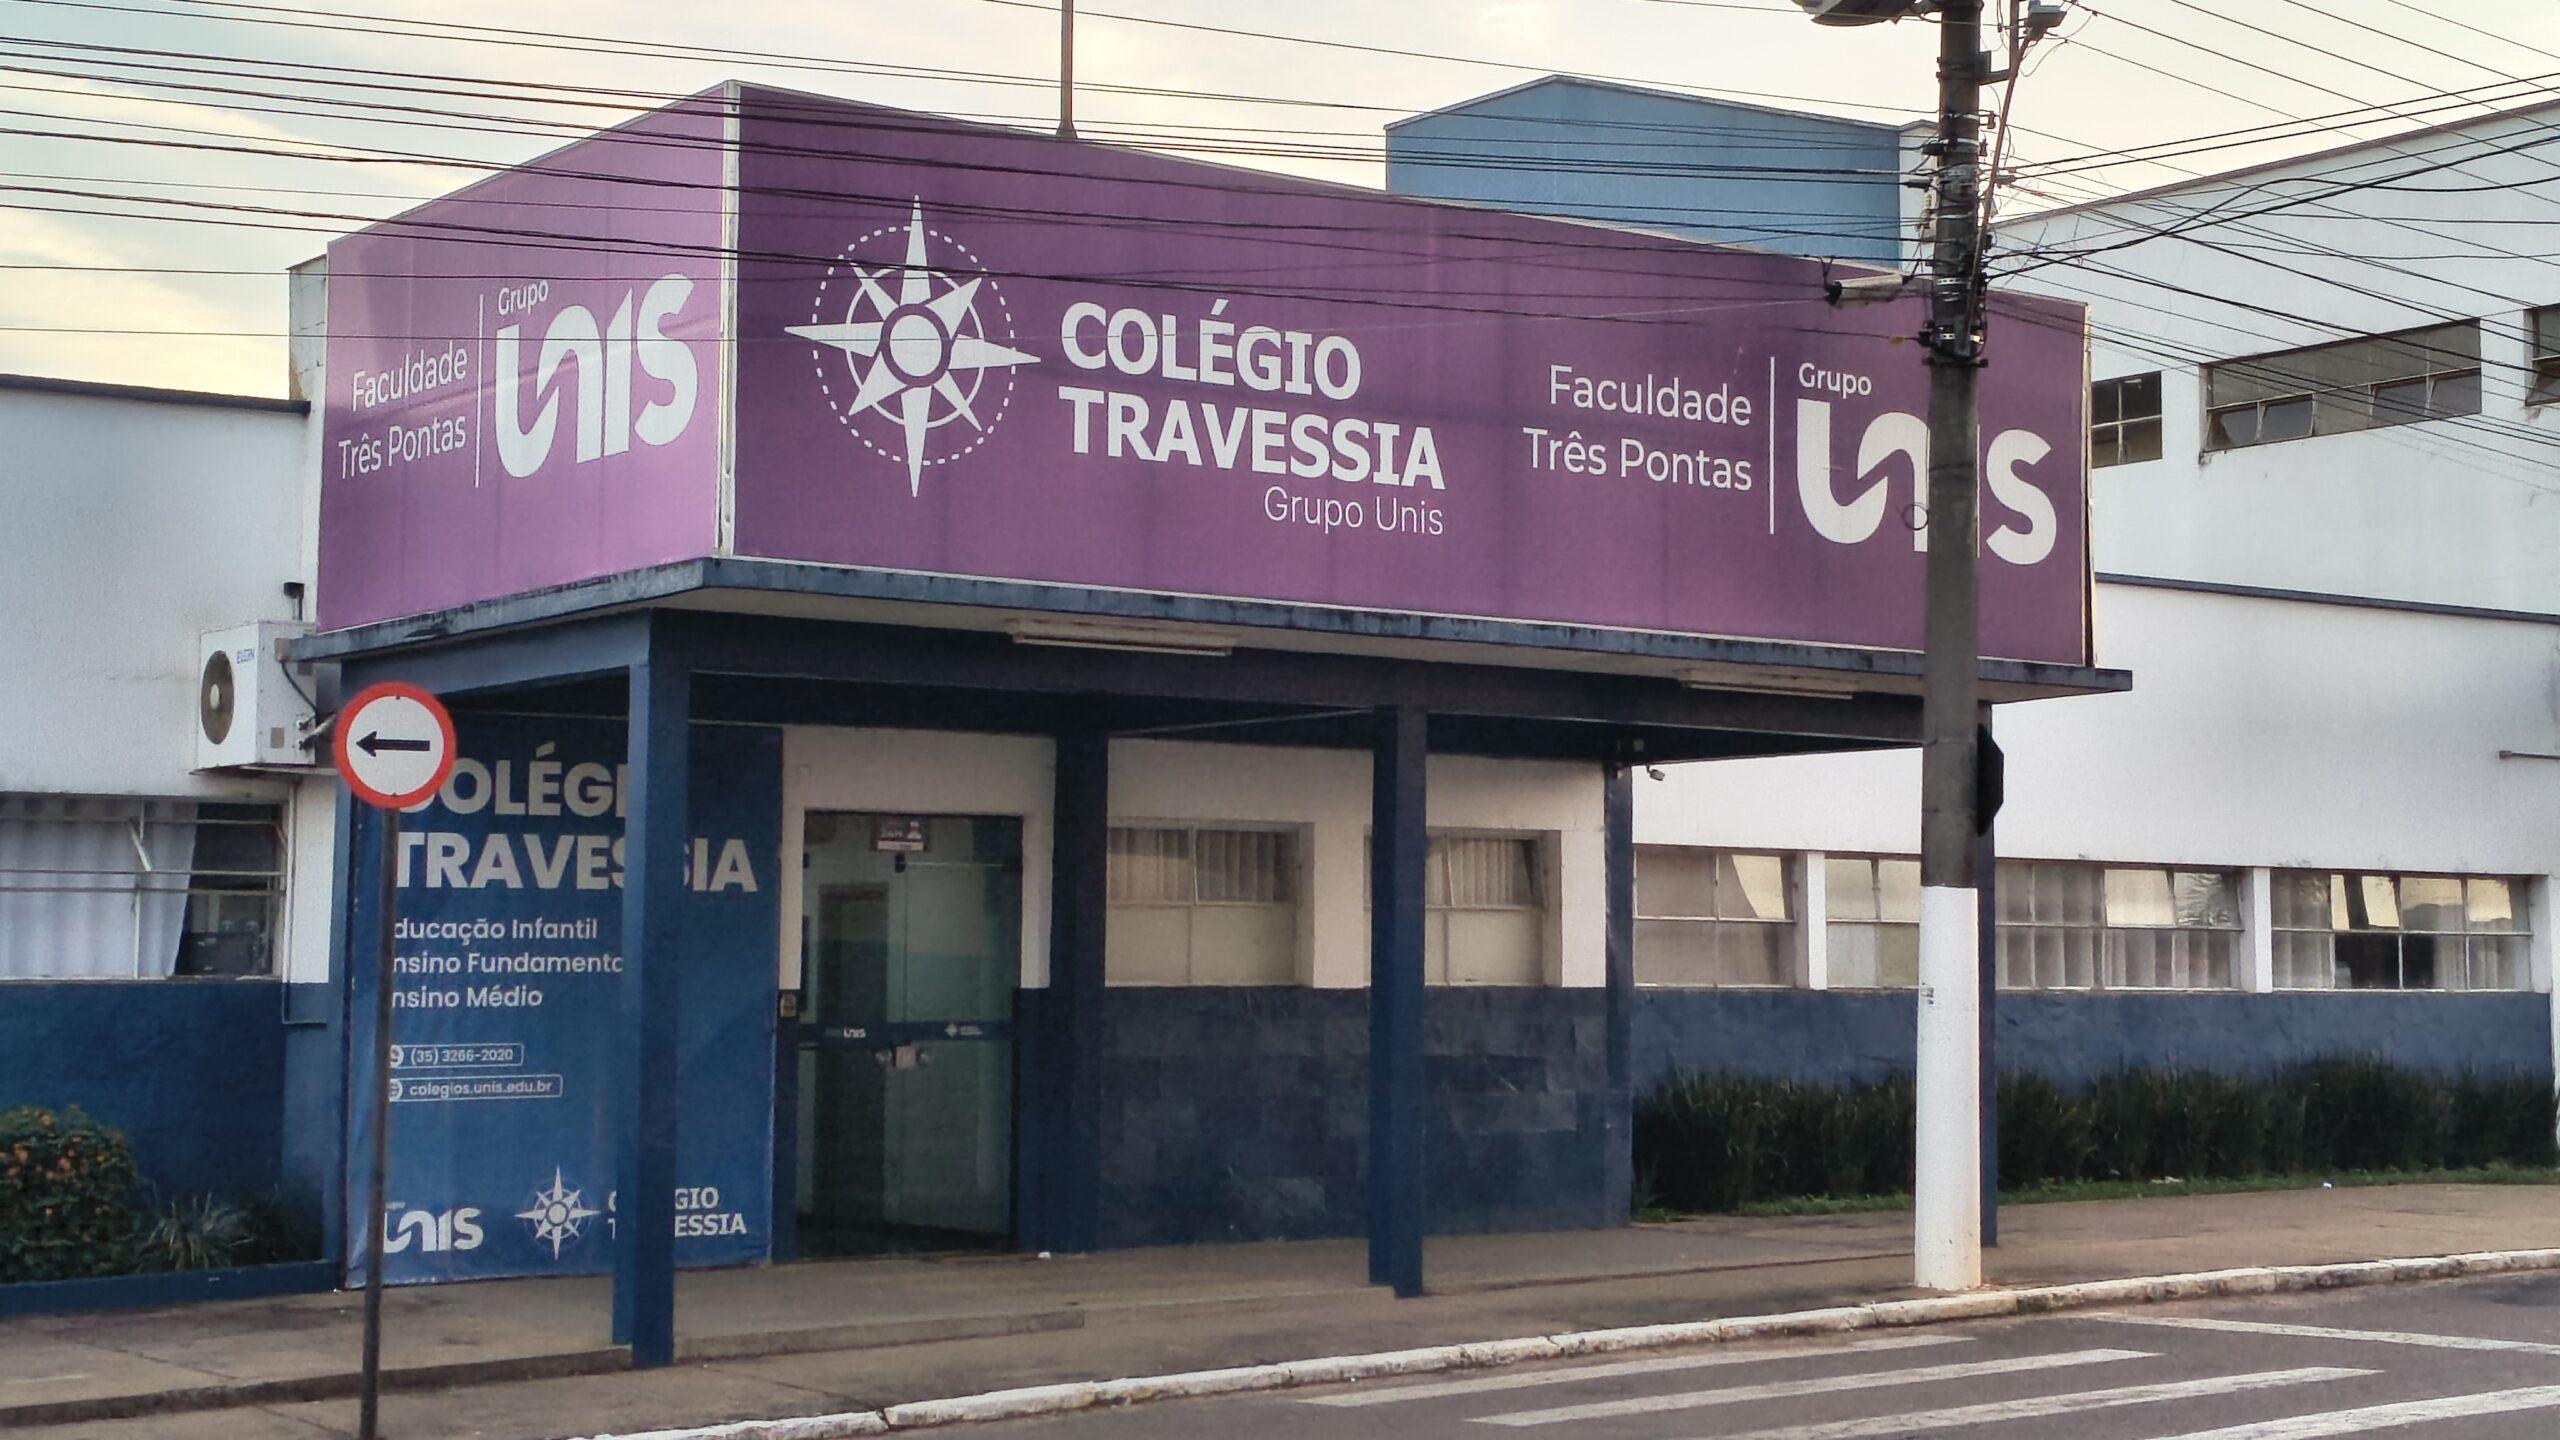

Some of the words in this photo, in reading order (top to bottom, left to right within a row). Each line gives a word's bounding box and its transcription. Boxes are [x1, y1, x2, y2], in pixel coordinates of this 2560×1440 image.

[498, 279, 550, 318] Grupo
[352, 341, 468, 412] Faculdade
[1061, 299, 1362, 400] COLÉGIO
[1549, 364, 1752, 427] Faculdade
[1798, 362, 1872, 400] Grupo
[338, 433, 382, 480] Três
[388, 414, 467, 466] Pontas
[1058, 385, 1446, 490] TRAVESSIA
[1523, 426, 1607, 476] Três
[1620, 438, 1753, 491] Pontas
[1264, 486, 1364, 534] Grupo
[1376, 496, 1444, 535] Unis
[400, 740, 628, 818] OLÉGI
[396, 831, 759, 893] TRAVEIA
[394, 918, 505, 945] ducação
[512, 918, 598, 939] Infantil
[393, 951, 461, 973] nsino
[467, 952, 623, 974] Fundamenta
[391, 985, 460, 1008] nsino
[466, 984, 544, 1008] Médio
[410, 1047, 439, 1066] (35)
[442, 1048, 514, 1063] 3266-2020
[409, 1080, 553, 1100] colegios.unis.edu.br
